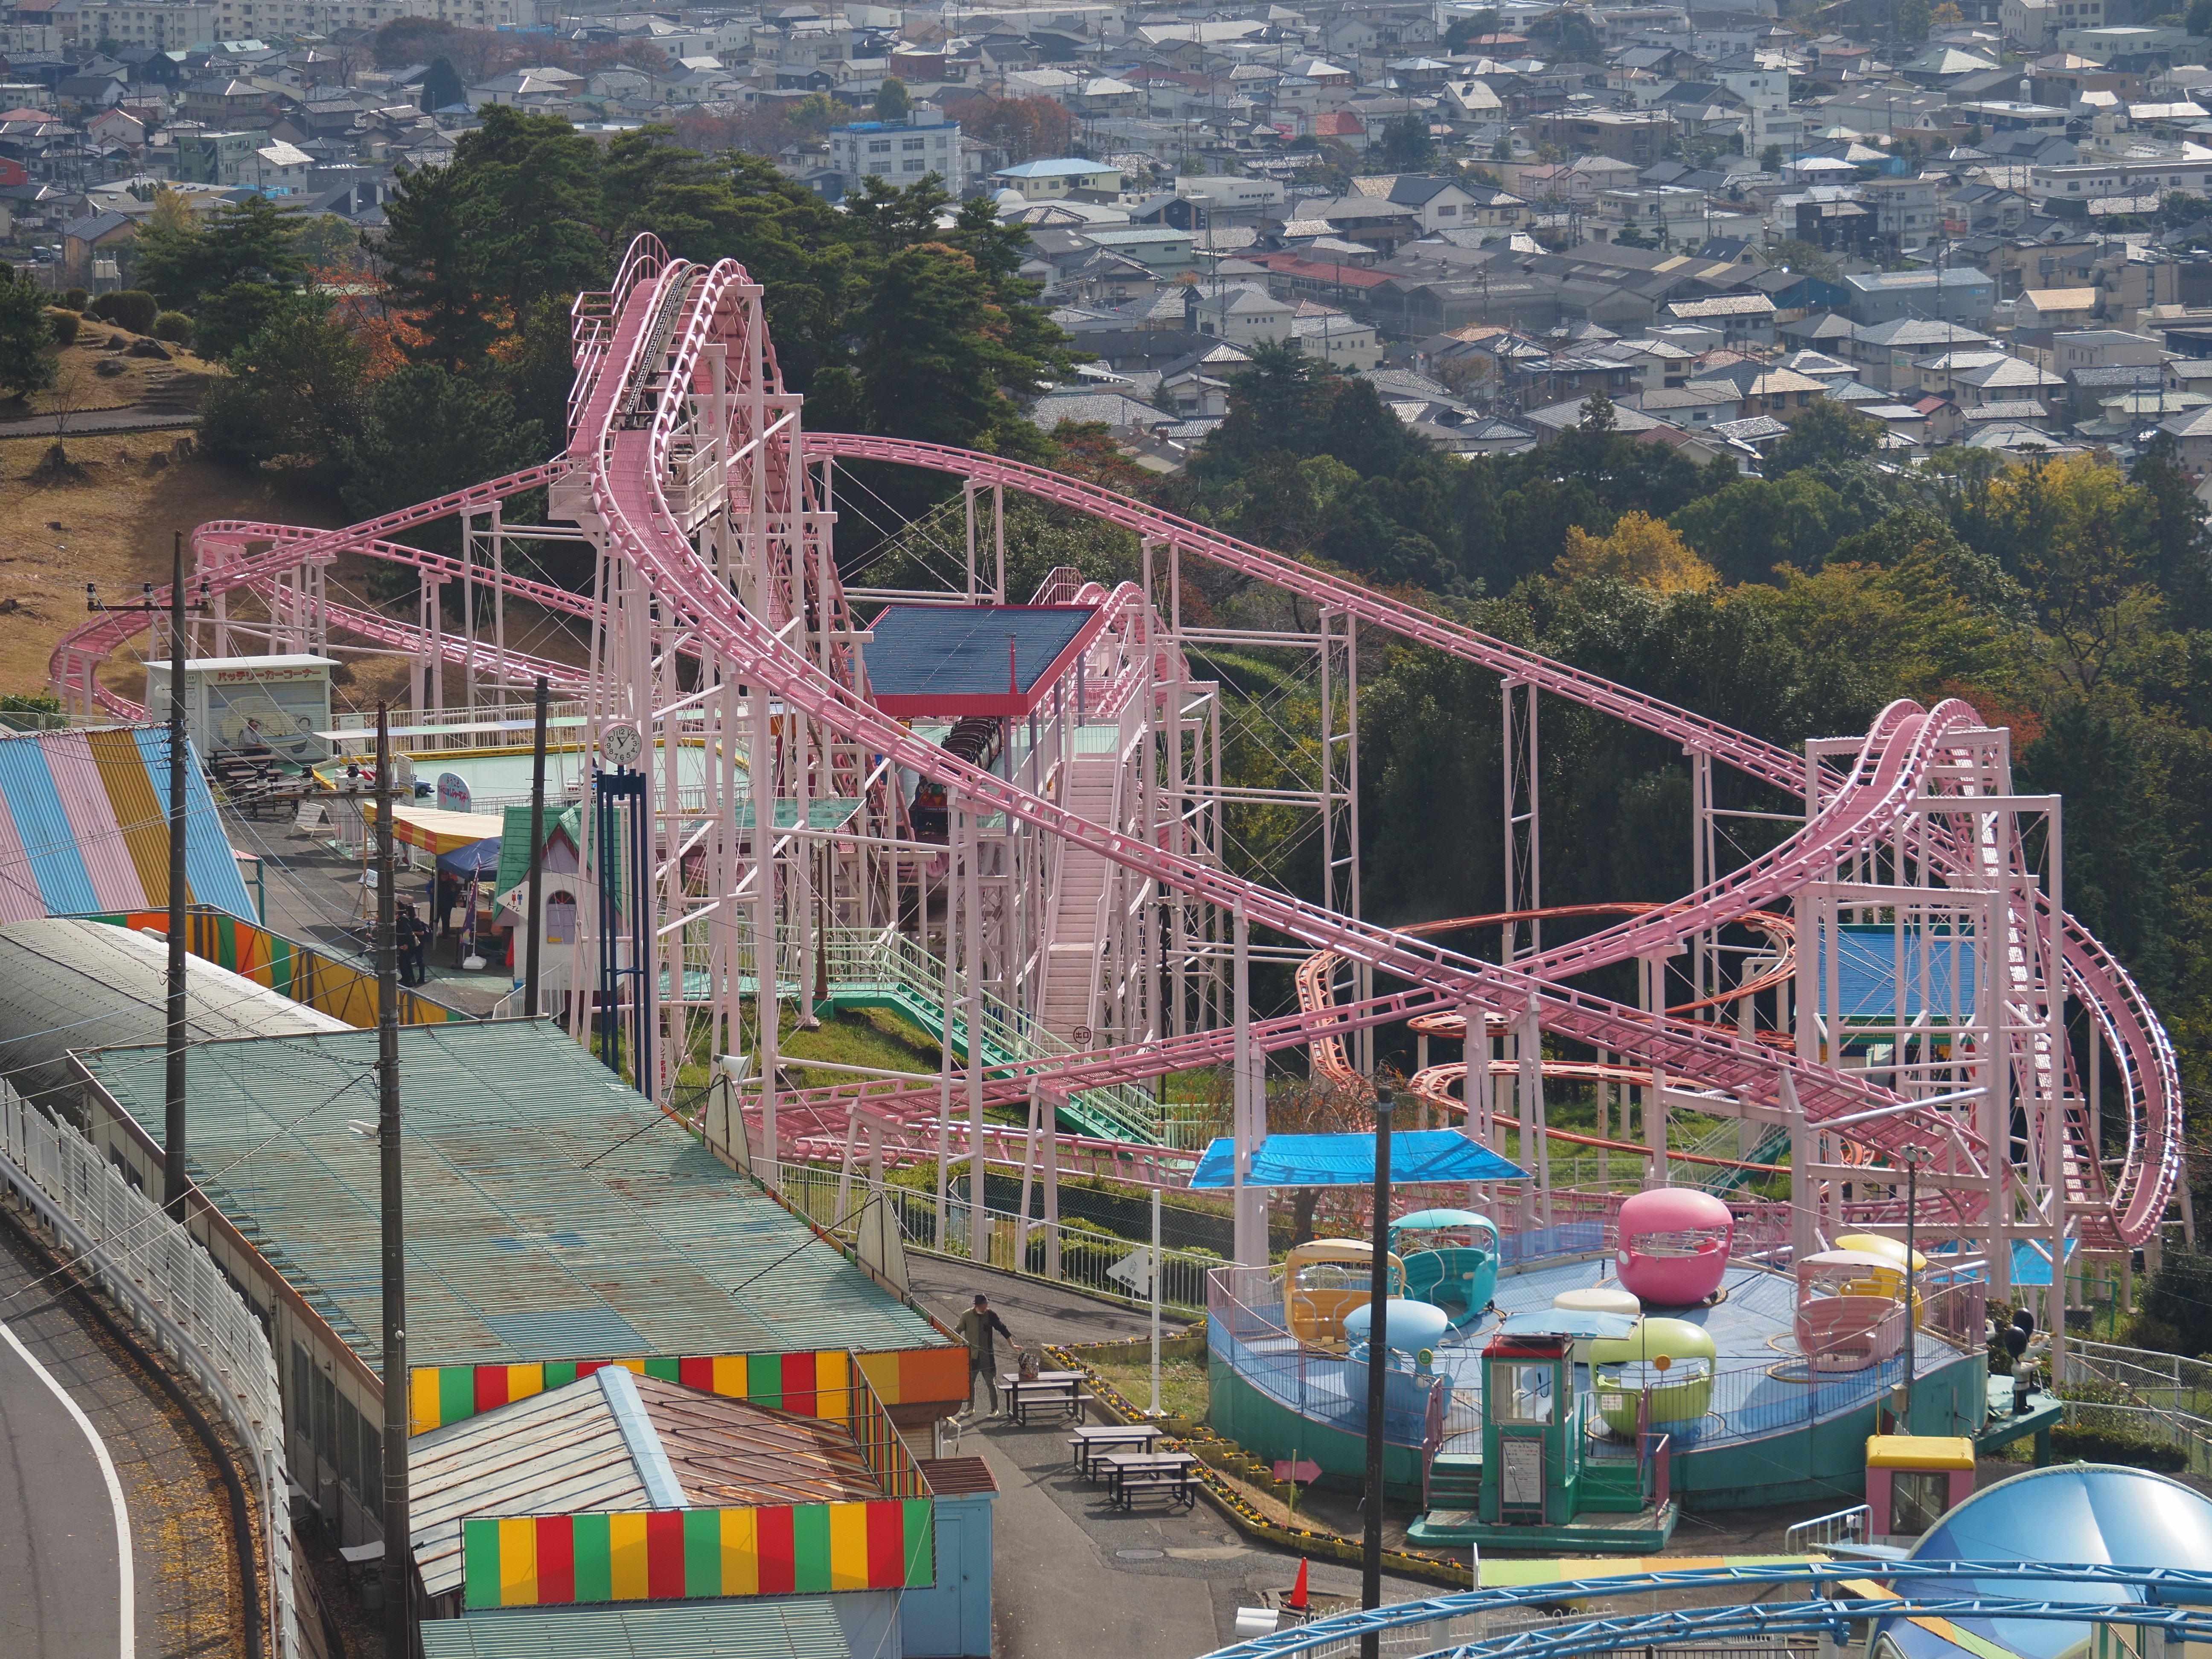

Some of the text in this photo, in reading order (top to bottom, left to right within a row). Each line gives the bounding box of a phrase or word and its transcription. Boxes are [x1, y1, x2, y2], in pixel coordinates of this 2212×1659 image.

[217, 669, 321, 681] バッテリーカーコーナー
[506, 902, 520, 911] トイレ
